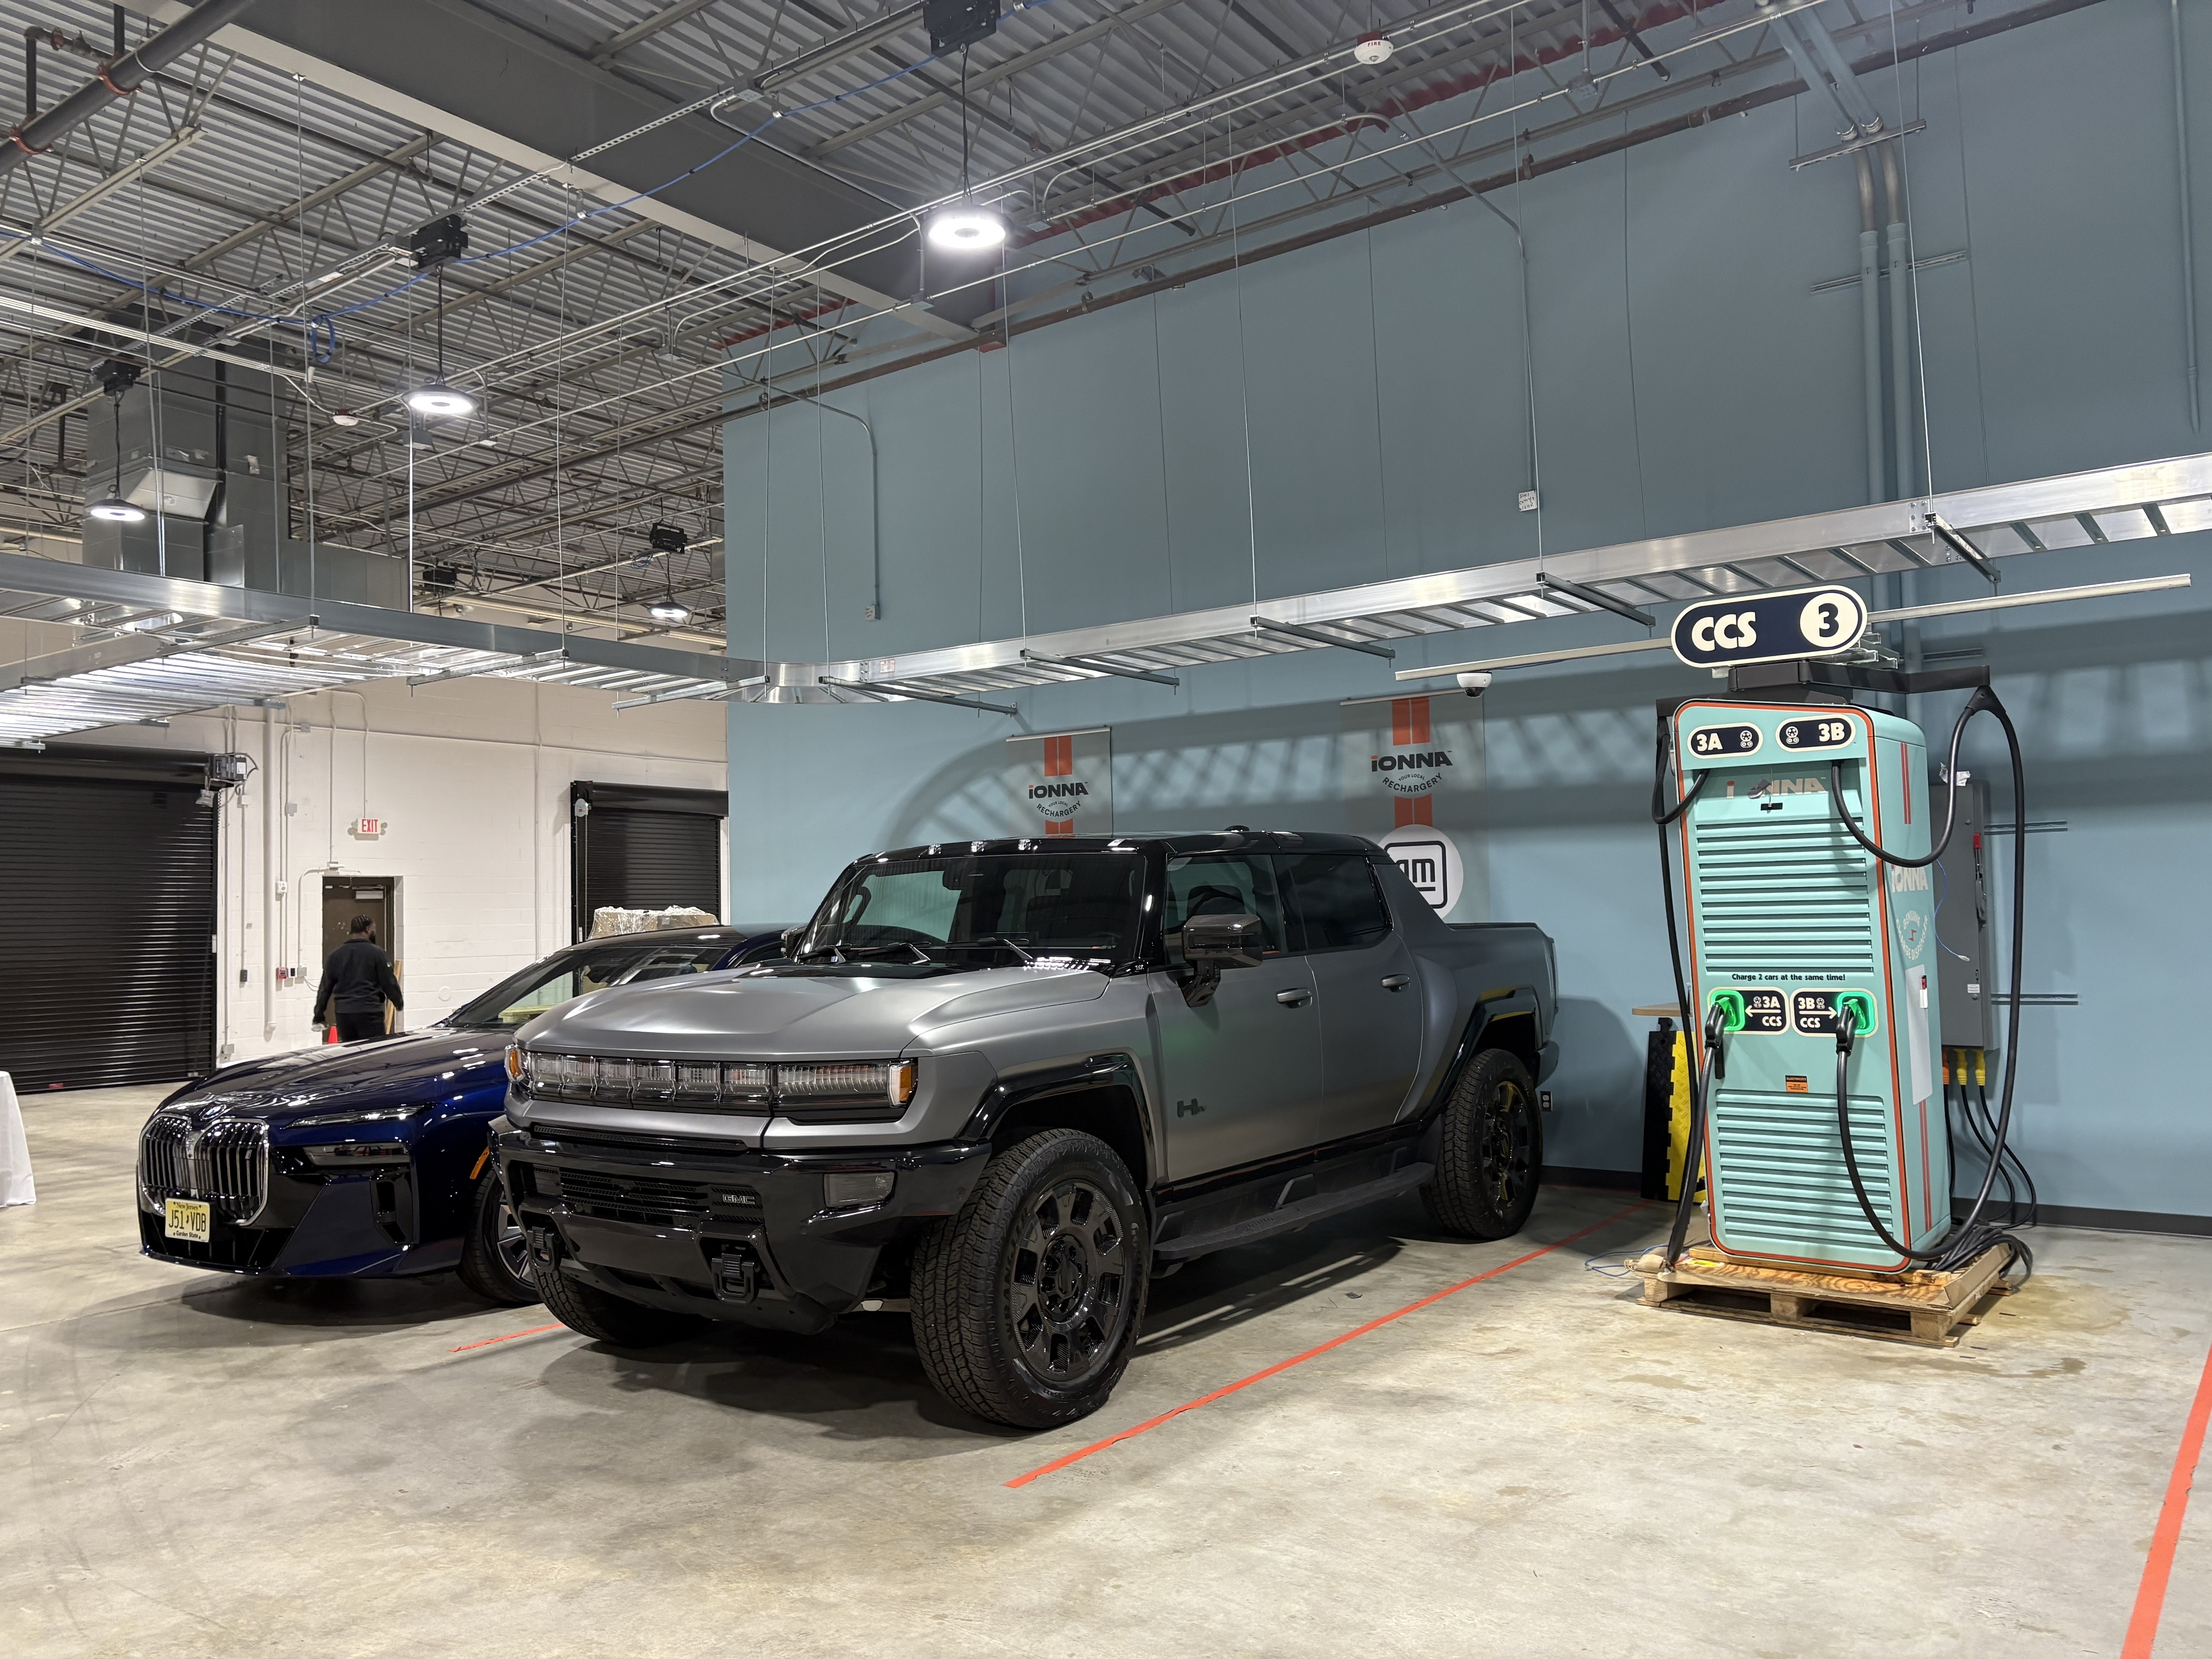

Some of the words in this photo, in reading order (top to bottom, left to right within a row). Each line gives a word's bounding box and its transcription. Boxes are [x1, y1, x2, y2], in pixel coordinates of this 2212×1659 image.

[1691, 611, 1757, 651] CCS
[1819, 603, 1840, 638] 3
[1819, 722, 1845, 743] 3B
[1696, 733, 1723, 752] 3A
[1382, 773, 1442, 792] RECHARGERY
[1727, 778, 1827, 798] iNNA
[1037, 800, 1081, 817] RECHARGERY
[362, 819, 378, 833] EXIT
[1763, 996, 1781, 1008] 3A
[1798, 997, 1815, 1009] 3B
[1762, 1016, 1782, 1026] CCS
[1800, 1018, 1820, 1028] CCS
[723, 1194, 755, 1205] GMC
[169, 1209, 184, 1229] J51
[191, 1212, 206, 1232] VDB
